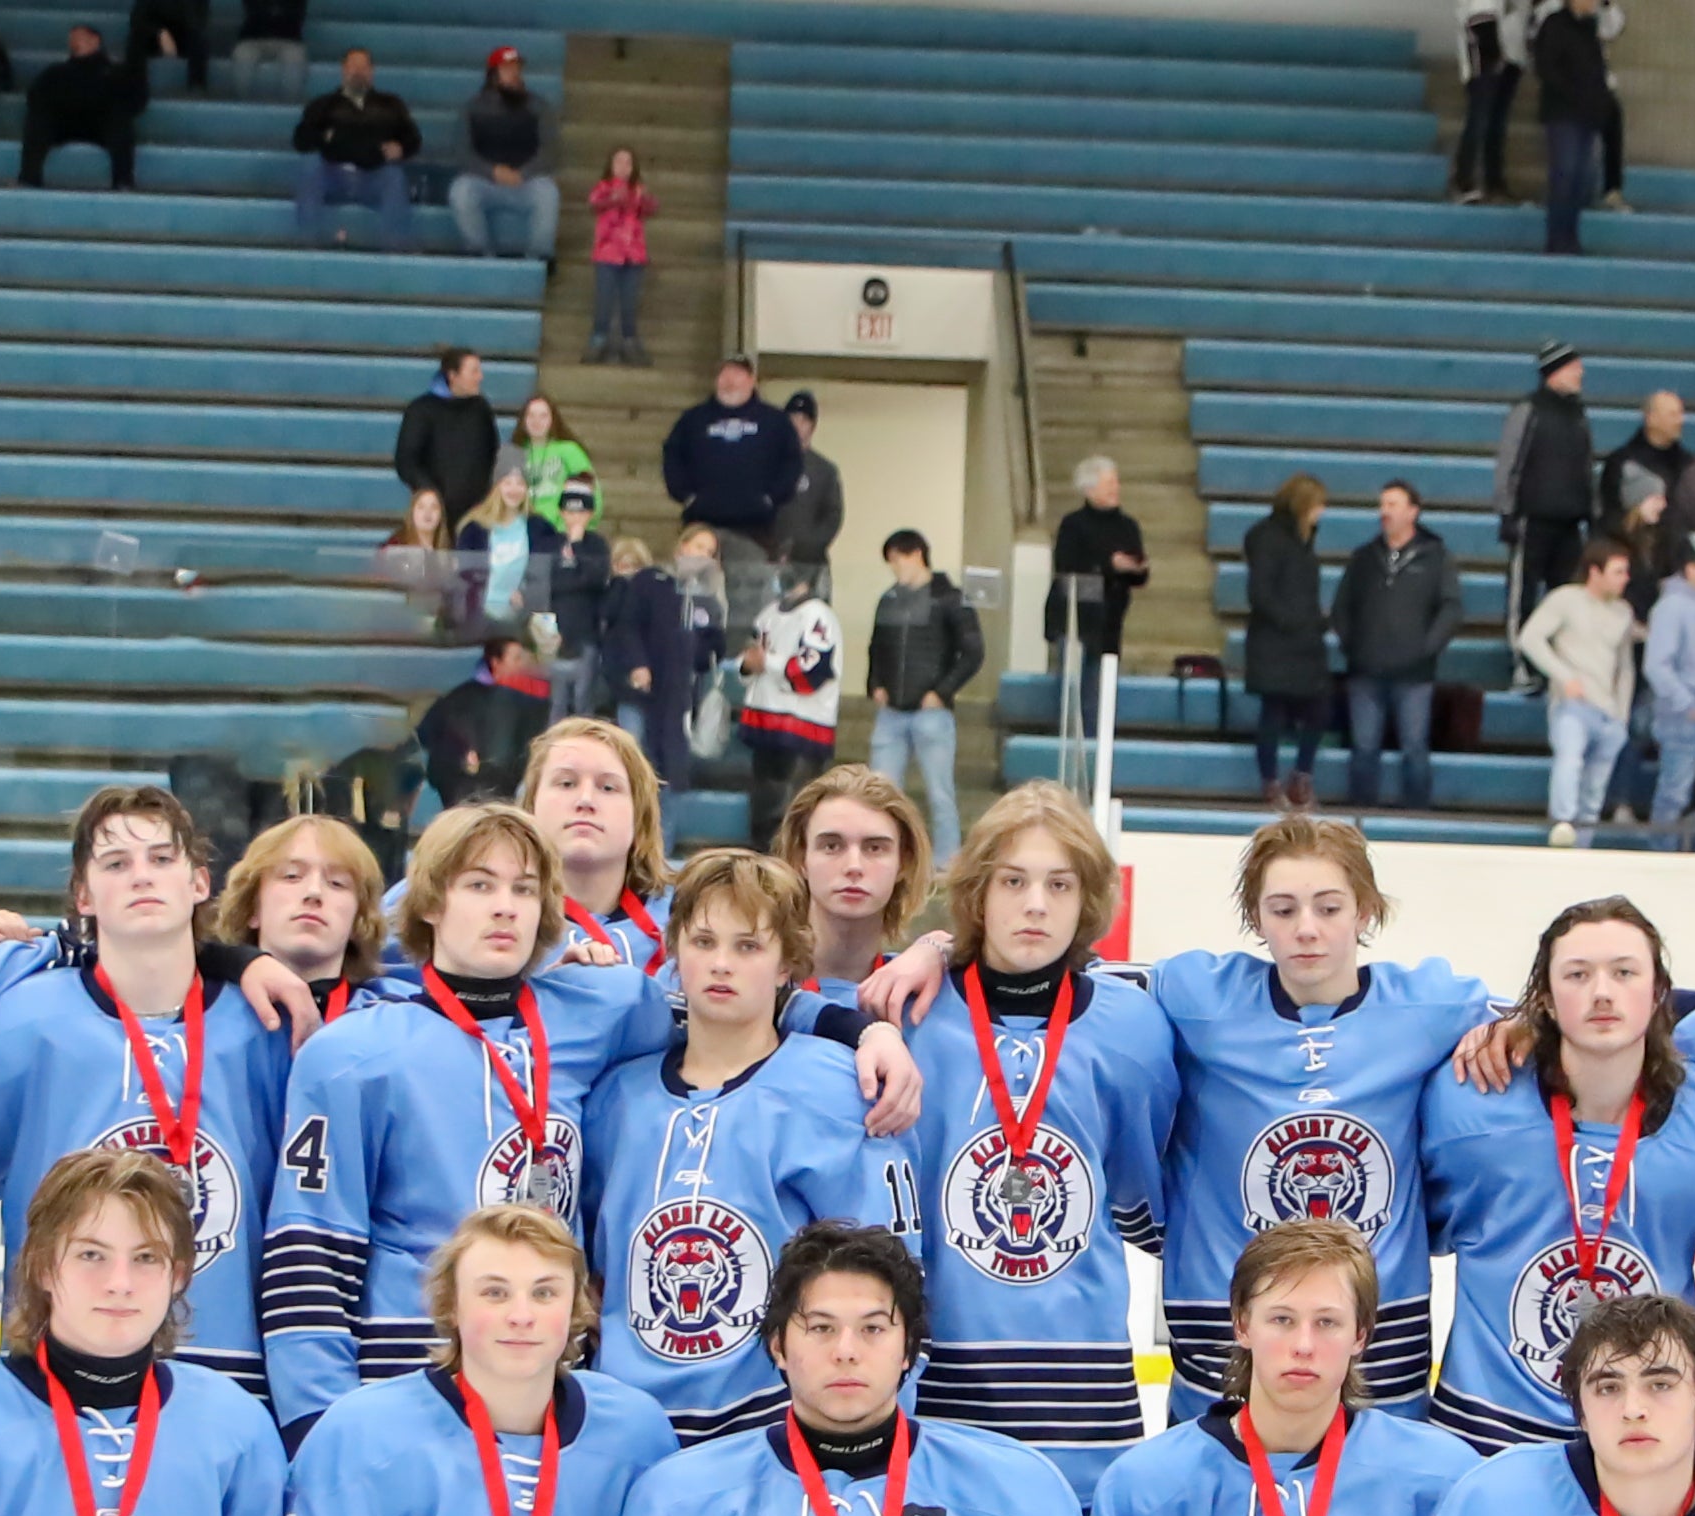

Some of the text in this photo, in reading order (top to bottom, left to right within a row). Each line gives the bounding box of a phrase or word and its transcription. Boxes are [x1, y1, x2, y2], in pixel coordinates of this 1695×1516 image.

[857, 313, 893, 340] EXIT
[284, 1115, 329, 1193] 4
[1042, 1136, 1074, 1172] LEA
[1264, 1119, 1374, 1158] ALBERT LEA
[643, 1205, 745, 1249] ALBERT LEA
[991, 1251, 1049, 1278] TIGERS
[1615, 1253, 1645, 1289] LEA
[660, 1330, 723, 1356] TIGERS
